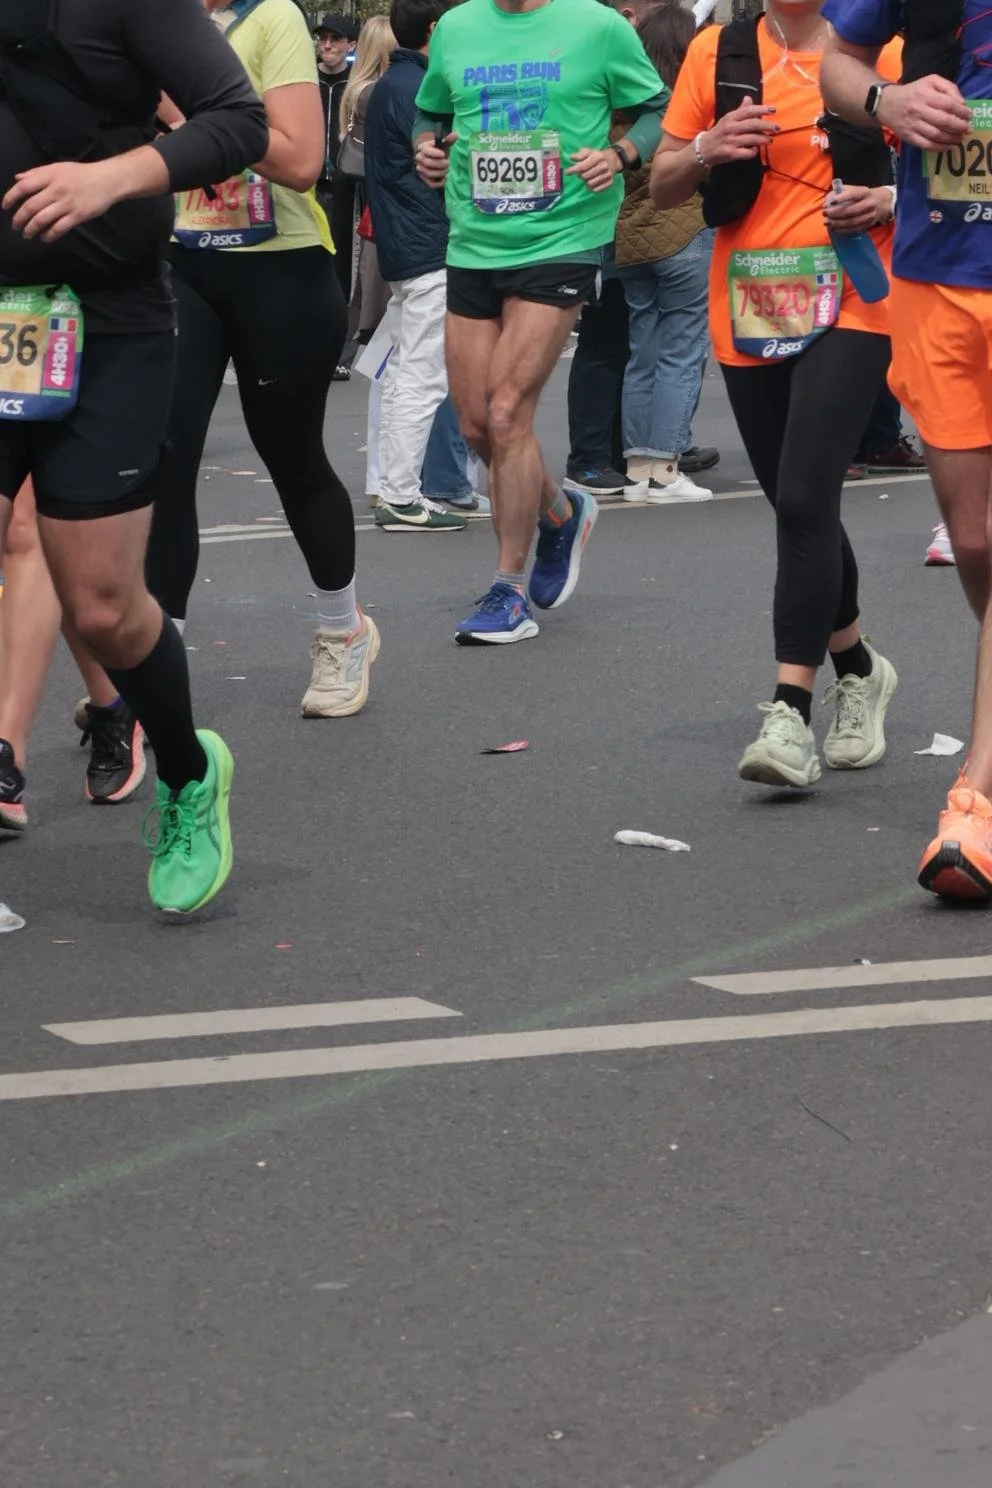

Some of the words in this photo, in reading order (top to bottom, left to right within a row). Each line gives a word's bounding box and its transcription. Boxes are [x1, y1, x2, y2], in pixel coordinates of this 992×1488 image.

[463, 63, 518, 87] PARIS
[521, 61, 560, 81] RUN
[479, 133, 532, 144] Schneider
[477, 157, 537, 183] 69269
[968, 183, 991, 194] NEIL
[507, 202, 536, 211] asics
[211, 234, 242, 246] asics
[735, 253, 800, 268] Schneider
[0, 323, 39, 366] 36
[50, 336, 69, 386] 4H30+
